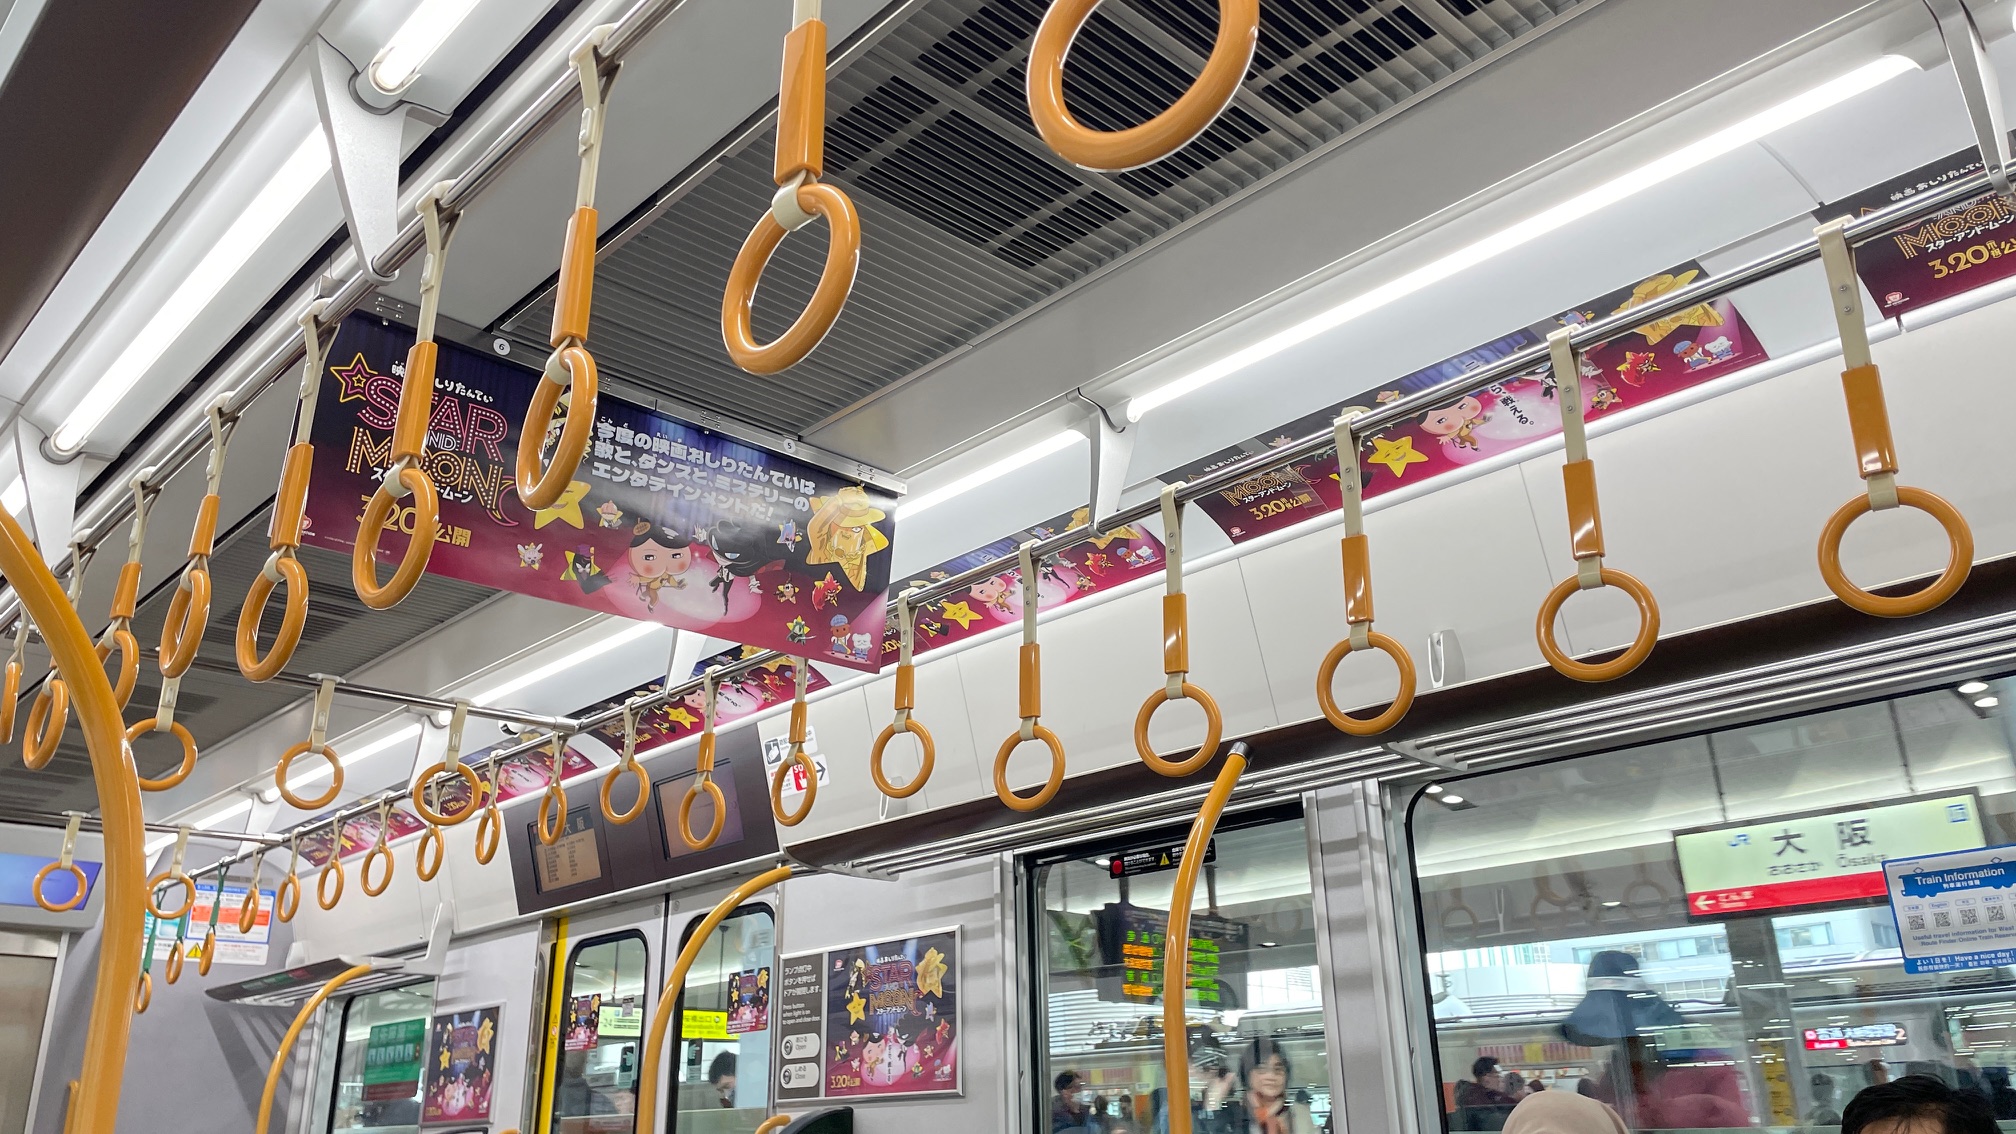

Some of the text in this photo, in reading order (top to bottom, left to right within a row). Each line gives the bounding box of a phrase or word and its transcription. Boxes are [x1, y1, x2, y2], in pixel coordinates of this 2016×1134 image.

[391, 360, 494, 403] 映しりたんてい
[357, 376, 508, 462] SAR
[345, 427, 505, 511] MON
[596, 421, 816, 496] 今度の映画おしりたんていは
[1727, 833, 1751, 847] JR
[1772, 818, 1873, 857] 大阪
[1915, 867, 2005, 886] Train Information
[1955, 954, 1972, 962] Have
